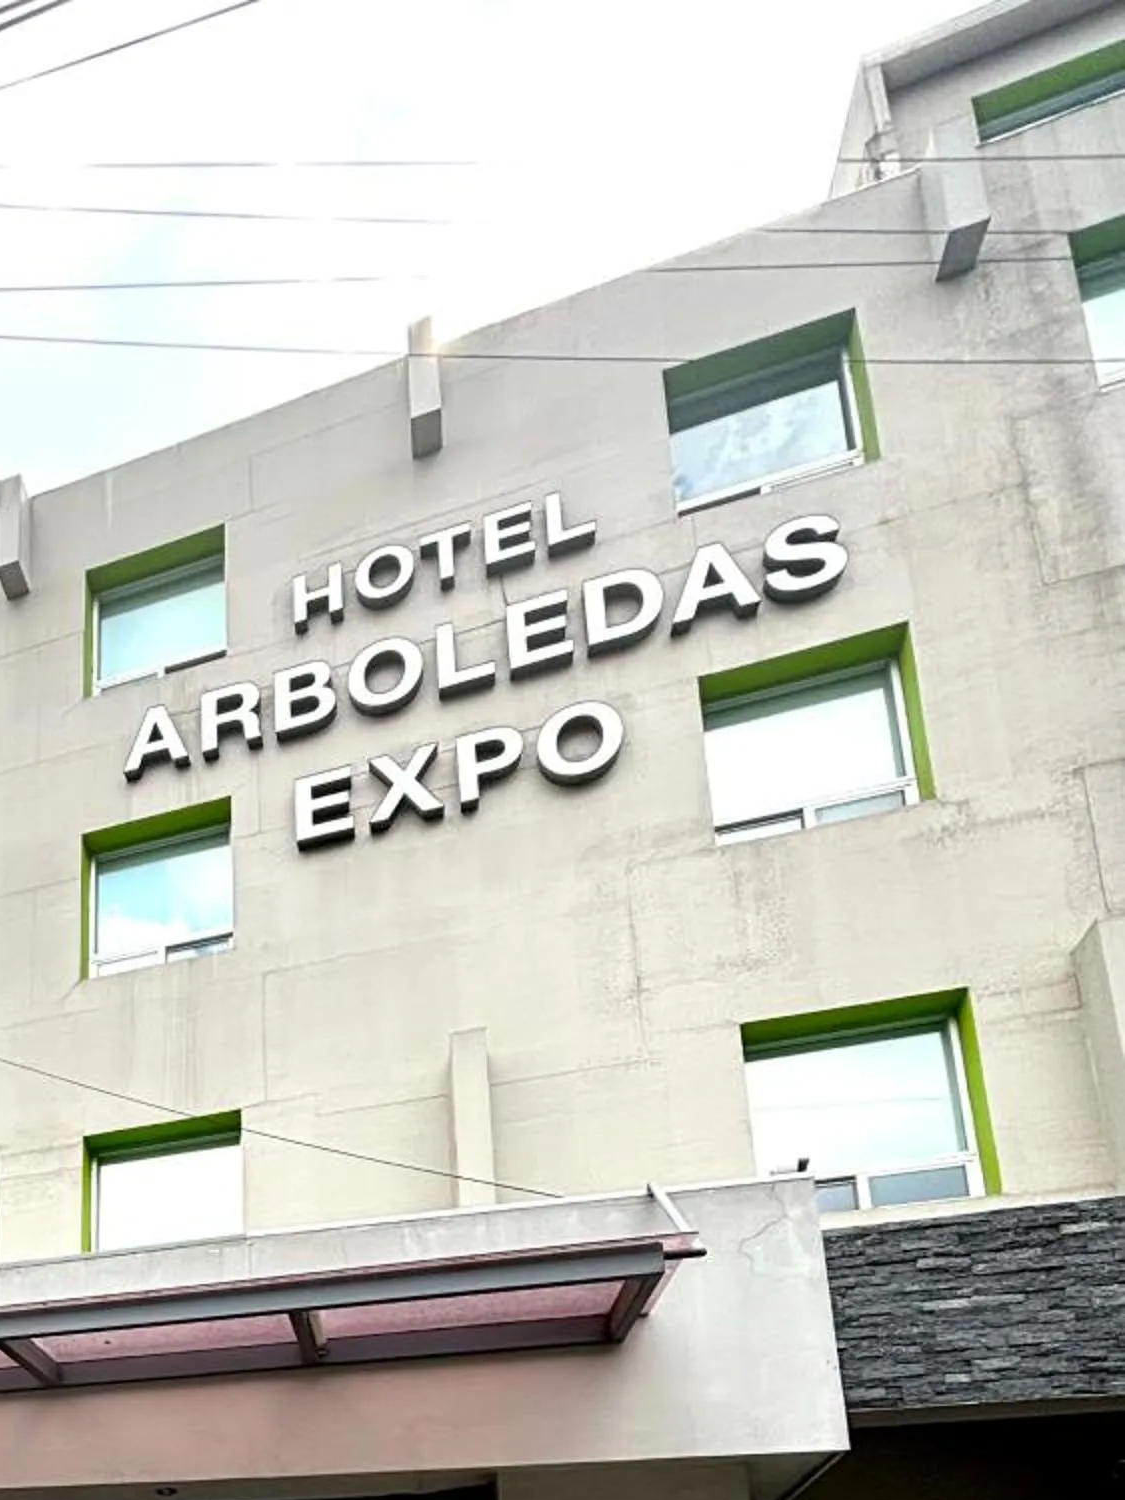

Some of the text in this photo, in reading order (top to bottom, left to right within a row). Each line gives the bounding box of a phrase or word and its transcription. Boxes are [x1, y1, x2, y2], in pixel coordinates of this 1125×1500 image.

[293, 492, 597, 634] HOTEL
[123, 514, 850, 781] ARBOLEDAS
[295, 700, 626, 851] EXPO
